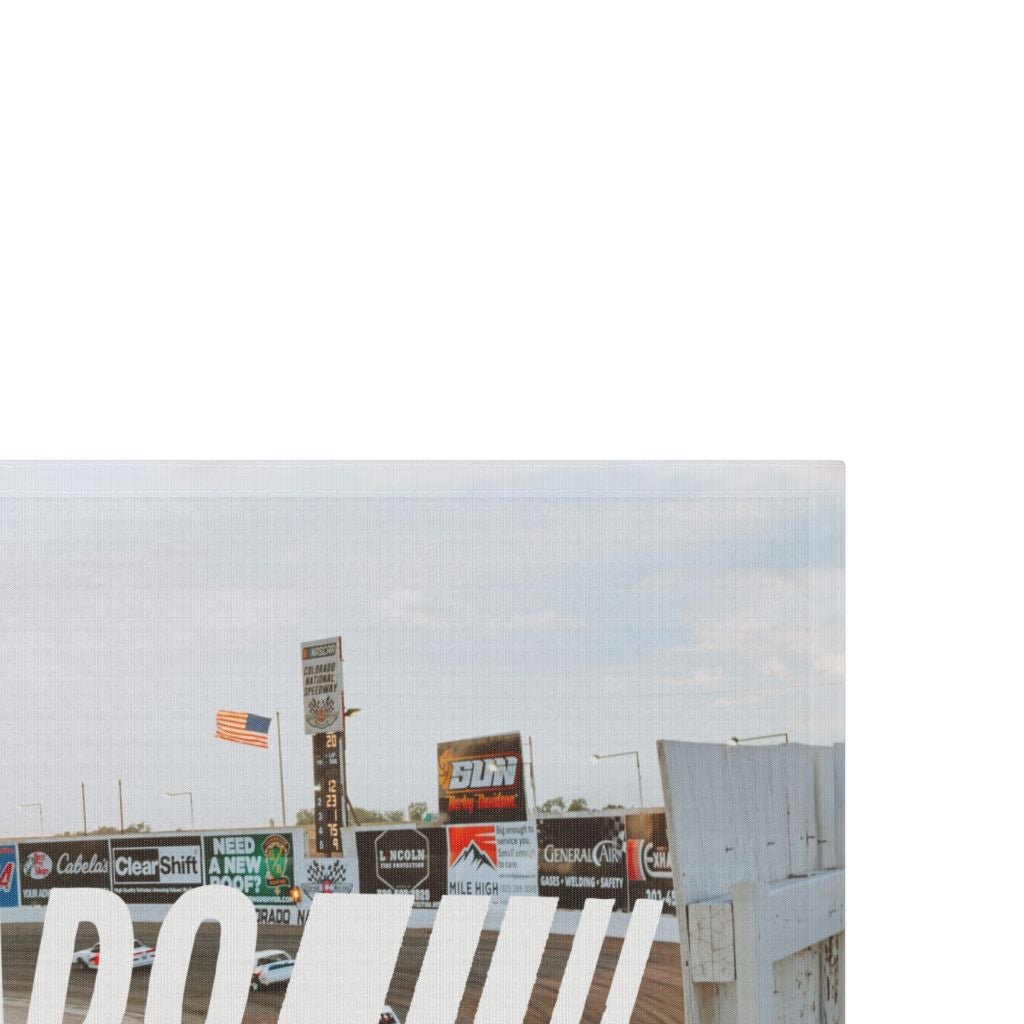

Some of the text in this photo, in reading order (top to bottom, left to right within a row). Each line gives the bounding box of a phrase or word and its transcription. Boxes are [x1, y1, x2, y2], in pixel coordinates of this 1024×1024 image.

[304, 663, 336, 676] COLORADO
[306, 673, 333, 686] NATIONAL
[304, 684, 337, 697] SPEEDWAY
[326, 734, 337, 748] 20
[448, 756, 517, 790] SUN
[328, 779, 337, 793] 12
[326, 794, 337, 808] 23
[213, 837, 256, 855] NEED
[56, 852, 108, 875] Cabela's
[115, 854, 198, 876] ClearShift
[209, 855, 262, 875] A NEW
[450, 881, 472, 895] MILE
[475, 881, 499, 896] HIGH
[541, 876, 560, 887] GASES
[565, 877, 596, 888] WELDING
[600, 877, 624, 889] SAFETY
